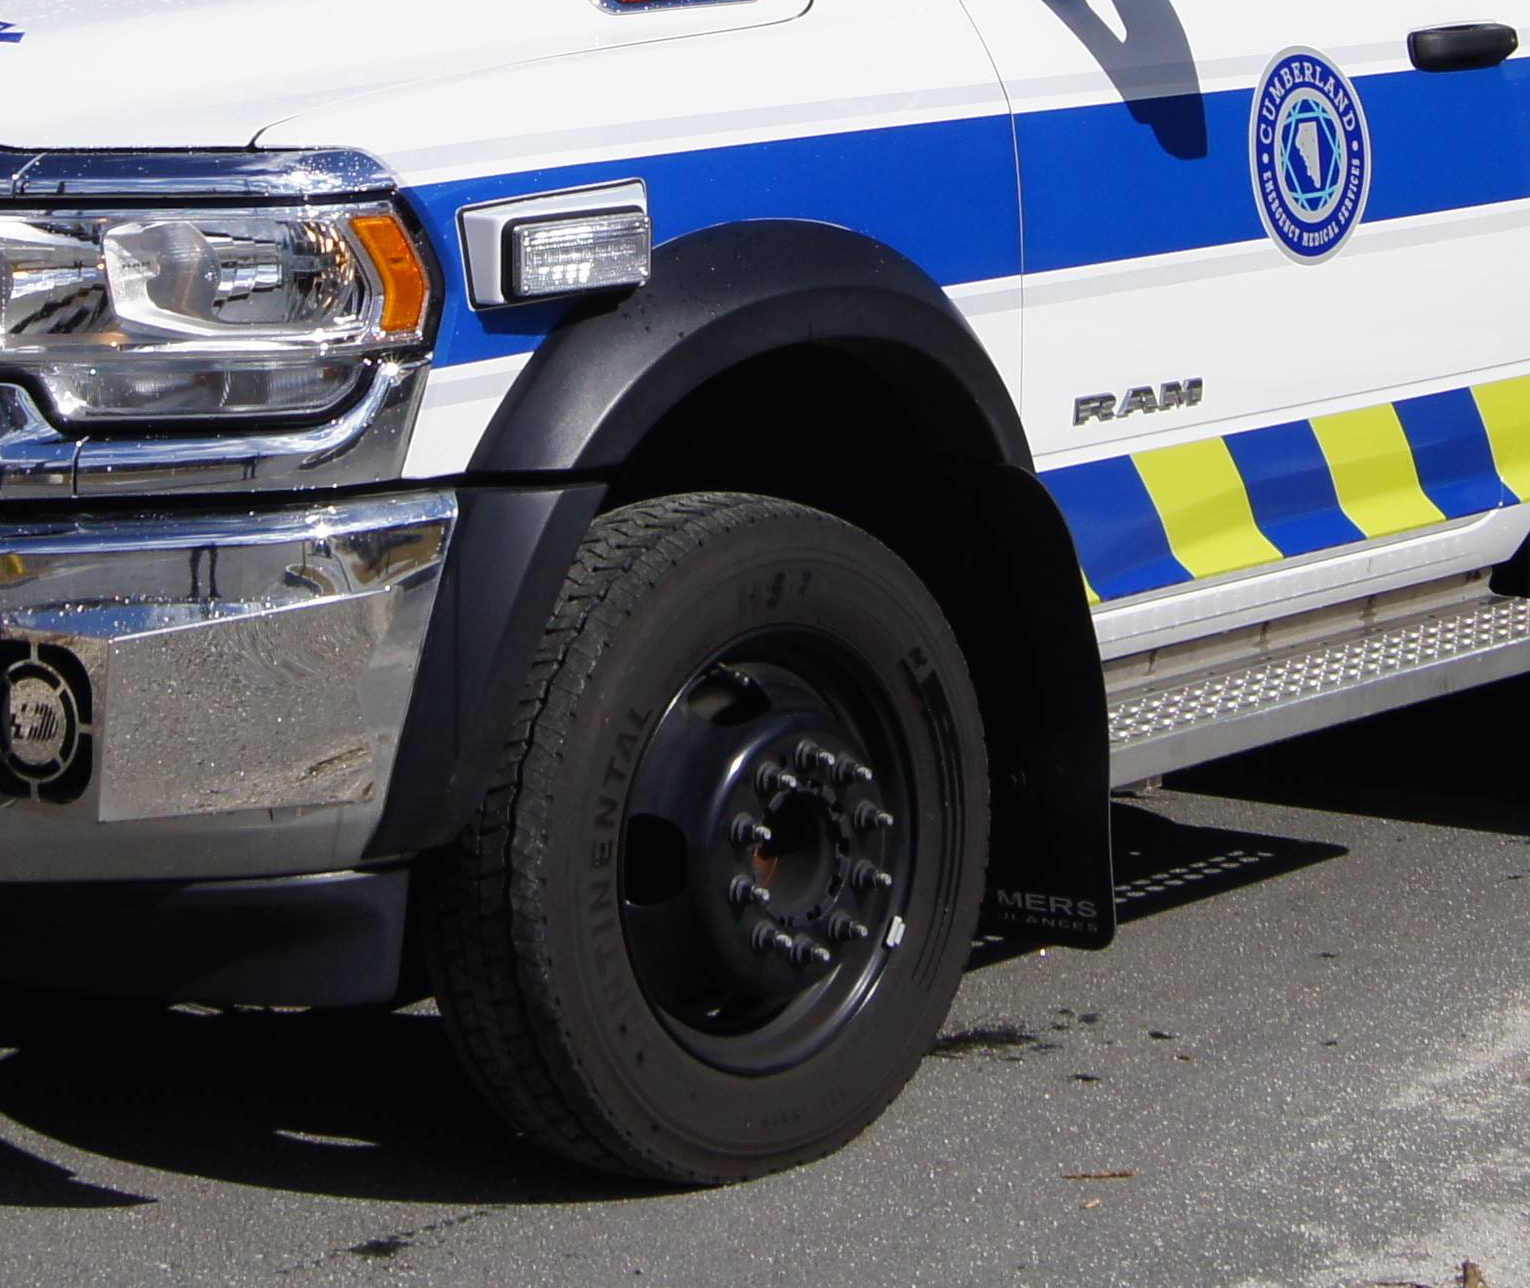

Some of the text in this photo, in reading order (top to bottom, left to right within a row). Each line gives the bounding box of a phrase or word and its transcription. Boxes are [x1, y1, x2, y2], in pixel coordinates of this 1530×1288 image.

[1259, 61, 1357, 146] CUMBERLAND
[1261, 158, 1361, 247] EMERGENCY MEDICAL SERVICES
[1072, 377, 1204, 427] RAM
[995, 888, 1098, 919] MERS
